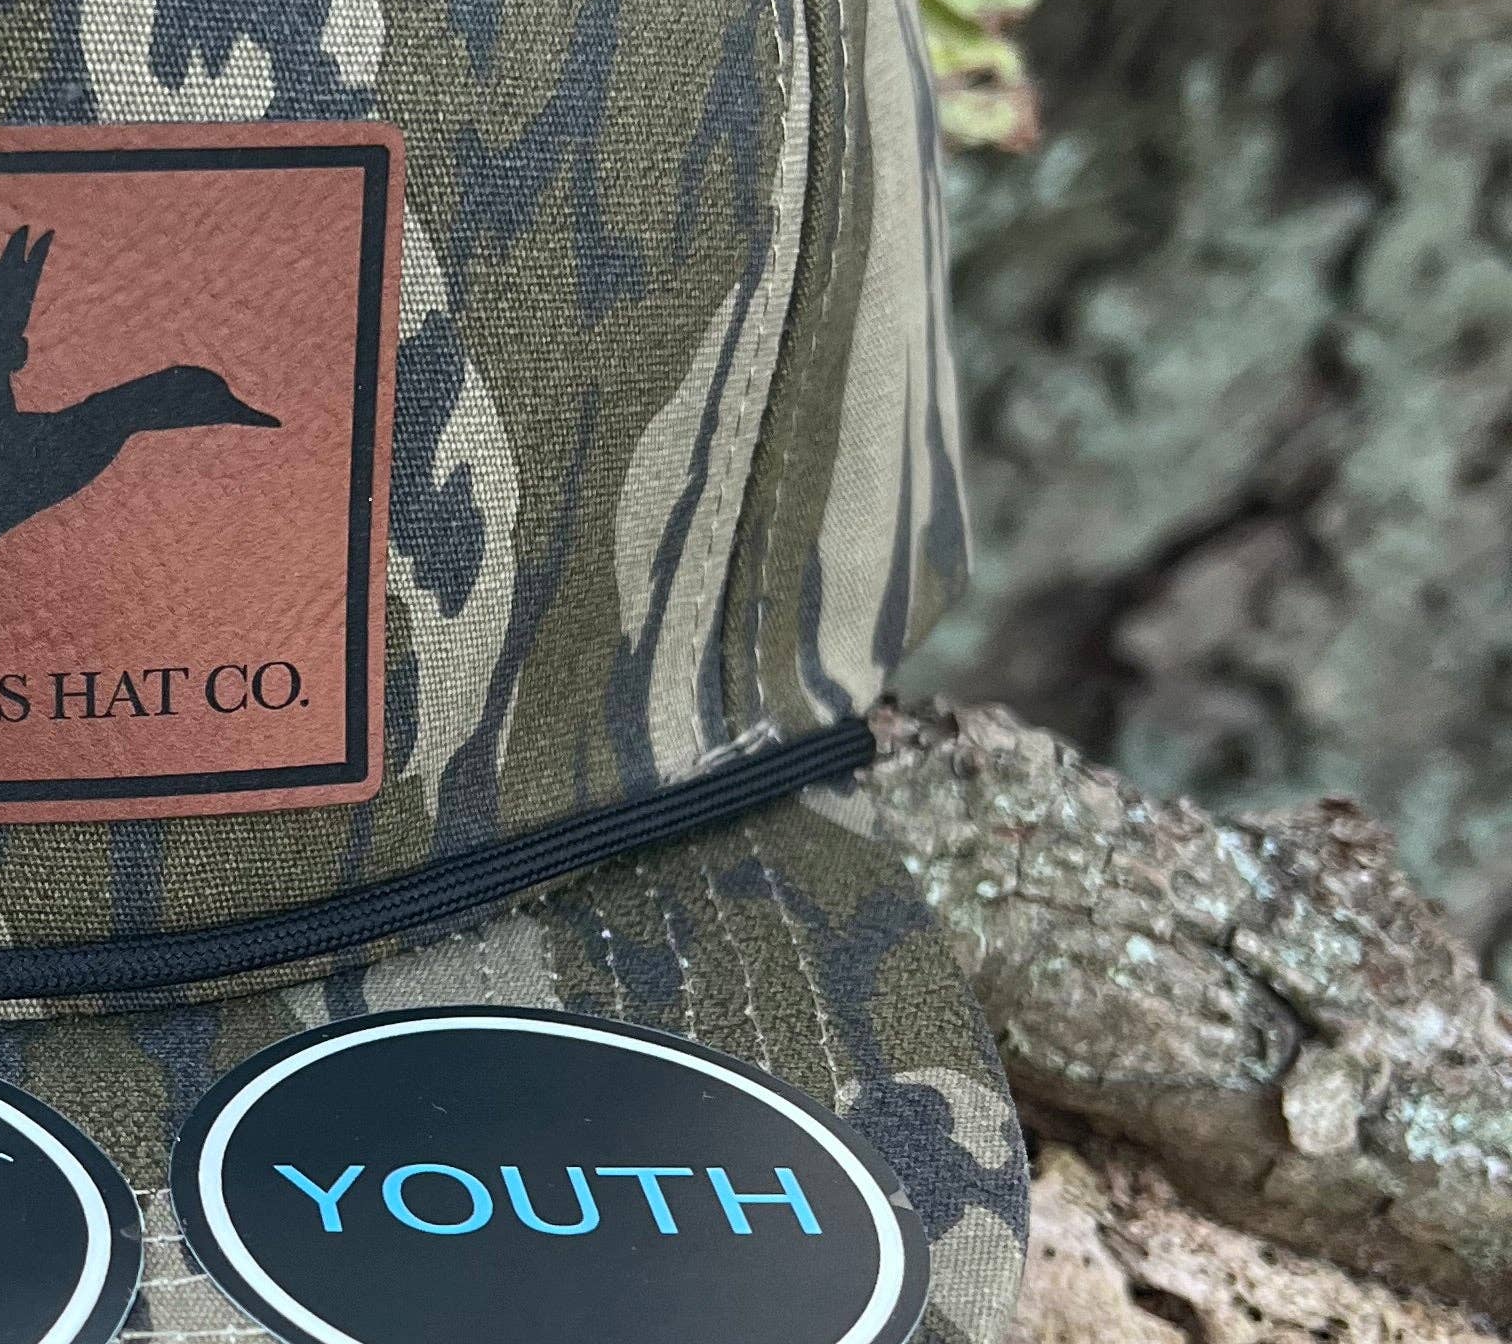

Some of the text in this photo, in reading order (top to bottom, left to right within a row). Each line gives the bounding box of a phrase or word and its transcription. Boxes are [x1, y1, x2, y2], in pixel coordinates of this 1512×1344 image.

[51, 666, 190, 720] HAT
[203, 660, 311, 713] CO.
[272, 1162, 823, 1237] YOUTH
